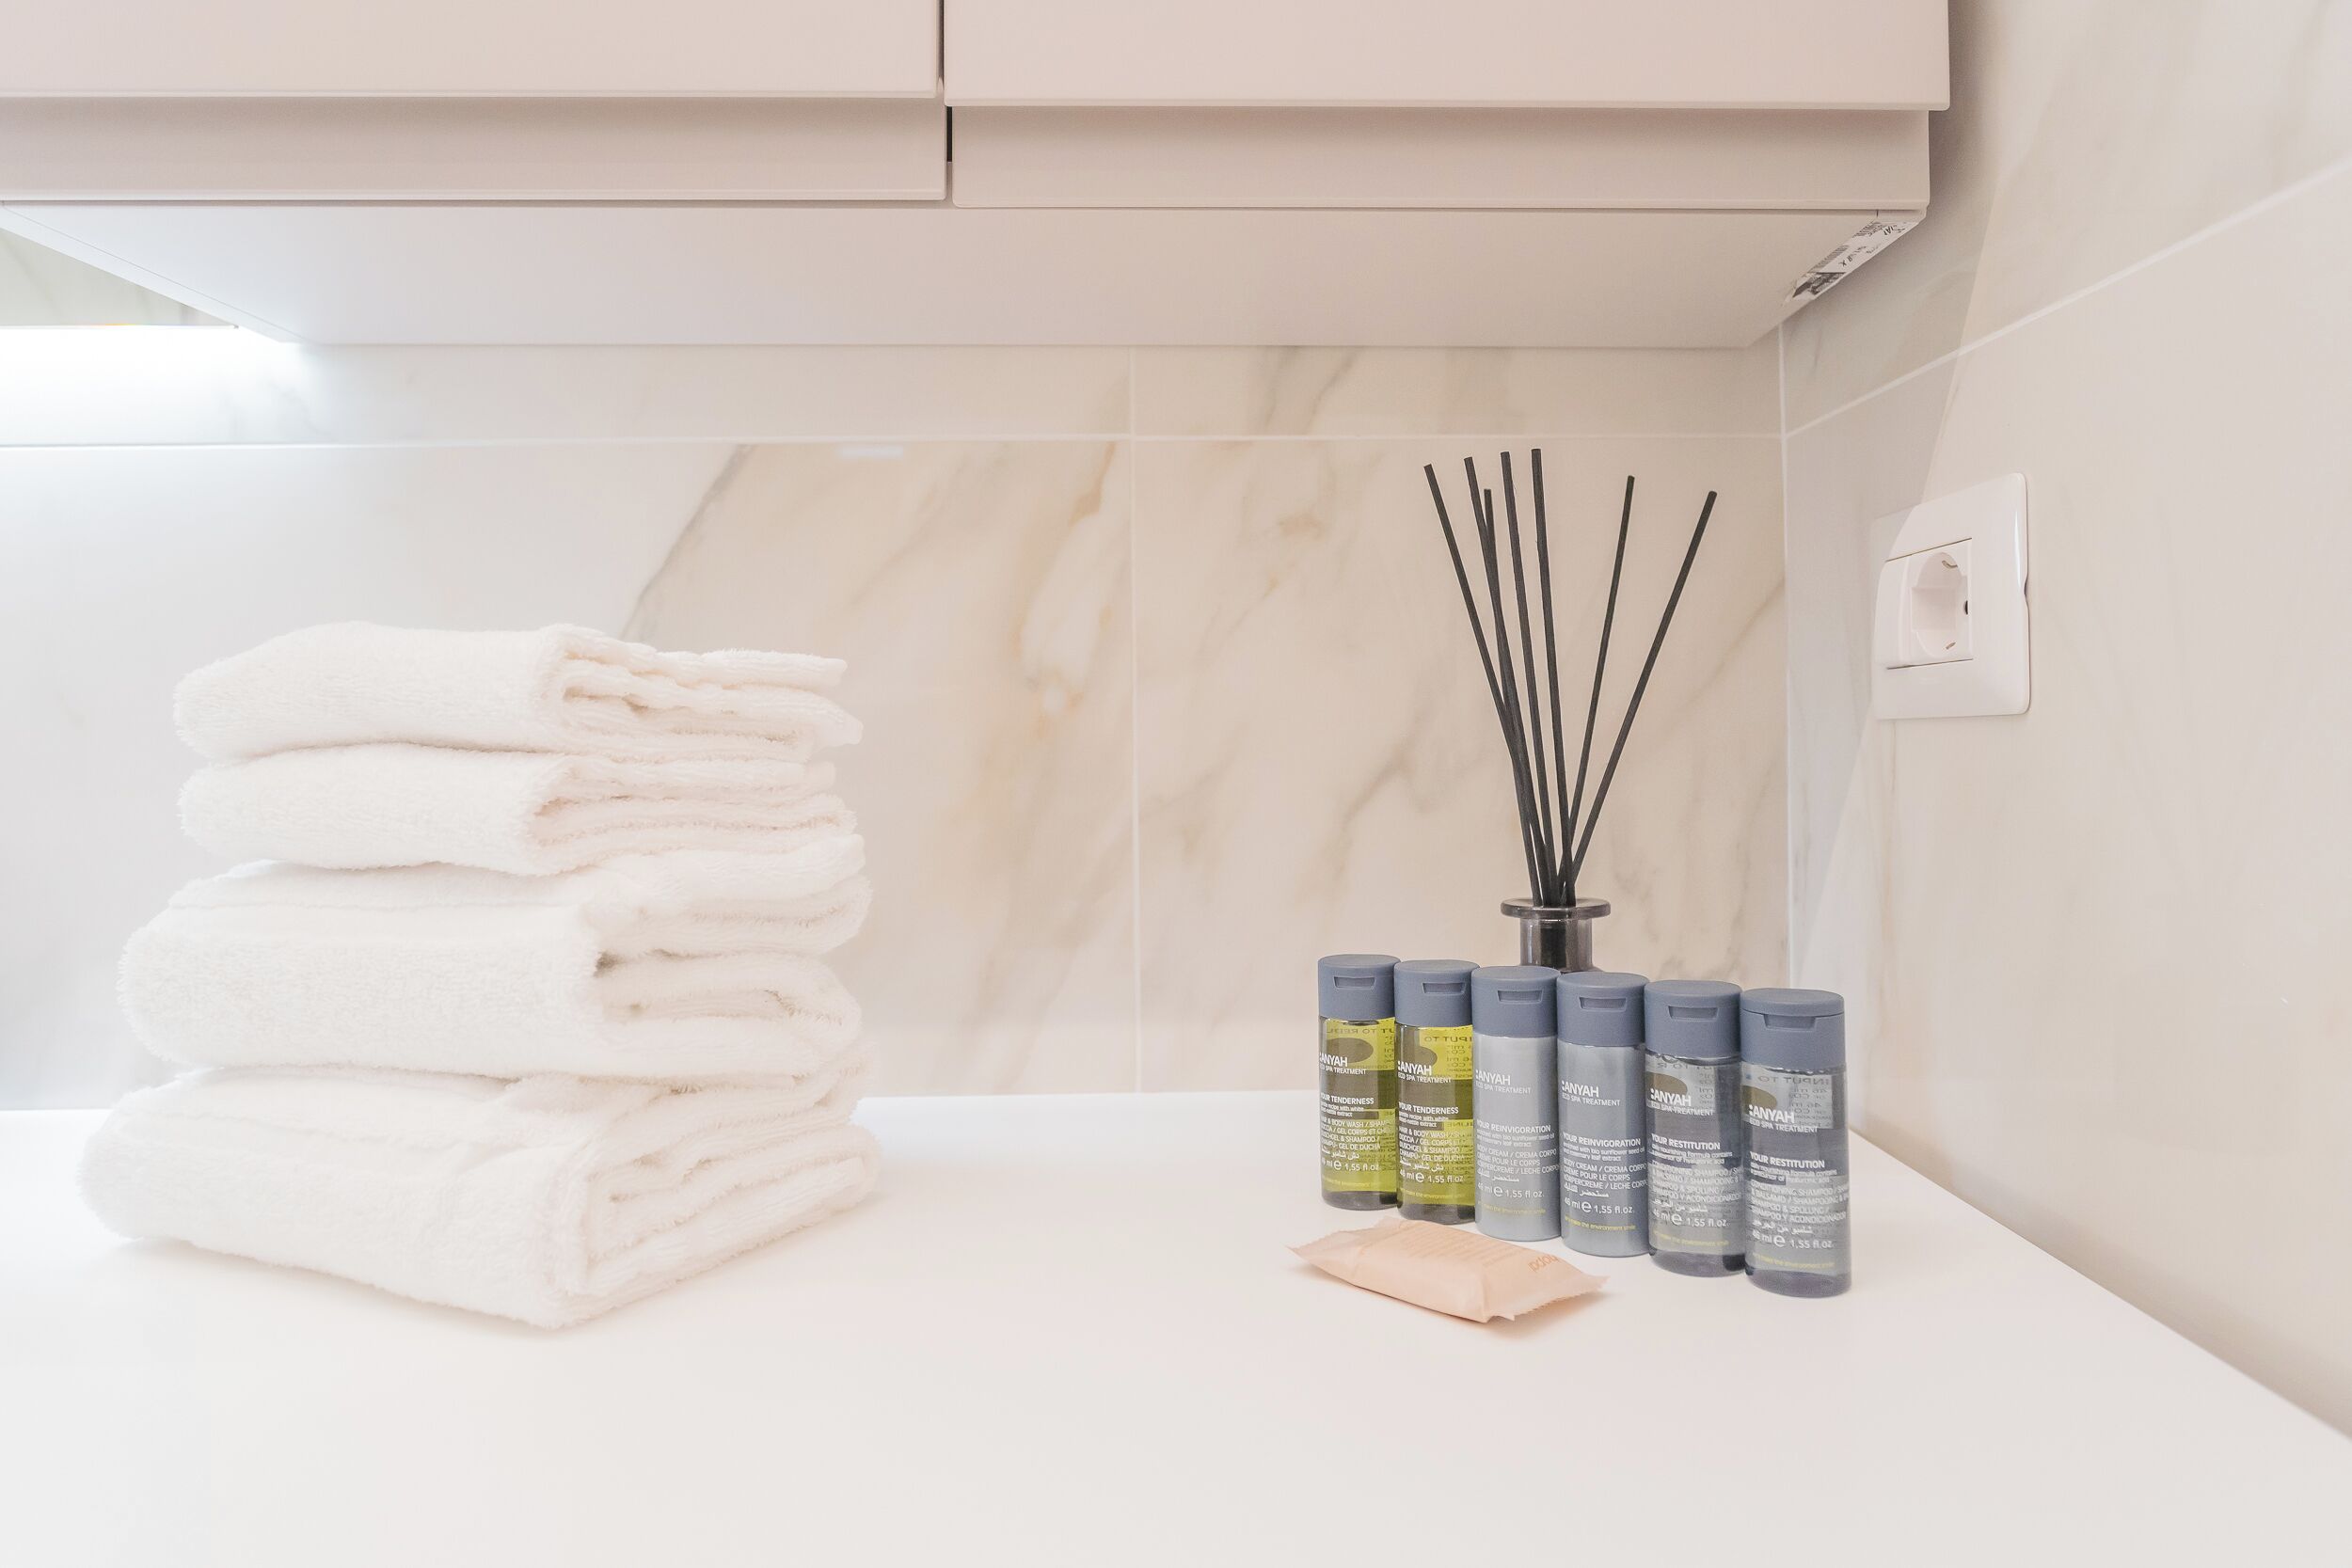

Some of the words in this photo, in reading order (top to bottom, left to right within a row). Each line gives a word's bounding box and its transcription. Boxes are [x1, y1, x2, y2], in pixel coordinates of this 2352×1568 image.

[1334, 1067, 1366, 1075] TREATMENT
[1495, 1085, 1533, 1094] TREATMENT
[1331, 1095, 1375, 1105] TENDERNESS
[1571, 1095, 1581, 1103] SPA
[1582, 1097, 1621, 1107] TREATMENT
[1399, 1101, 1412, 1112] YOUR
[1412, 1104, 1459, 1115] TENDERNESS
[1674, 1106, 1714, 1117] TREATMENT
[1490, 1122, 1551, 1134] REINVIGORATION
[1760, 1120, 1773, 1130] SPA
[1774, 1123, 1819, 1132] TREATMENT
[1563, 1131, 1578, 1144] YOUR
[1578, 1136, 1642, 1148] REINVIGORATION
[1651, 1133, 1668, 1146] YOUR
[1668, 1139, 1722, 1150] RESTITUTION
[1488, 1148, 1509, 1158] CREAM
[1492, 1155, 1509, 1165] POUR
[1518, 1159, 1541, 1167] CORPS
[1750, 1150, 1769, 1164] YOUR
[1769, 1156, 1825, 1169] RESTITUTION
[1575, 1161, 1597, 1172] CREAM
[1604, 1165, 1629, 1174] CREMA
[1580, 1171, 1598, 1181] POUR
[1598, 1173, 1608, 1181] LE
[1608, 1173, 1631, 1182] CORPS
[1610, 1181, 1631, 1191] LECHE
[1571, 1199, 1581, 1210] ml
[1762, 1232, 1772, 1243] ml
